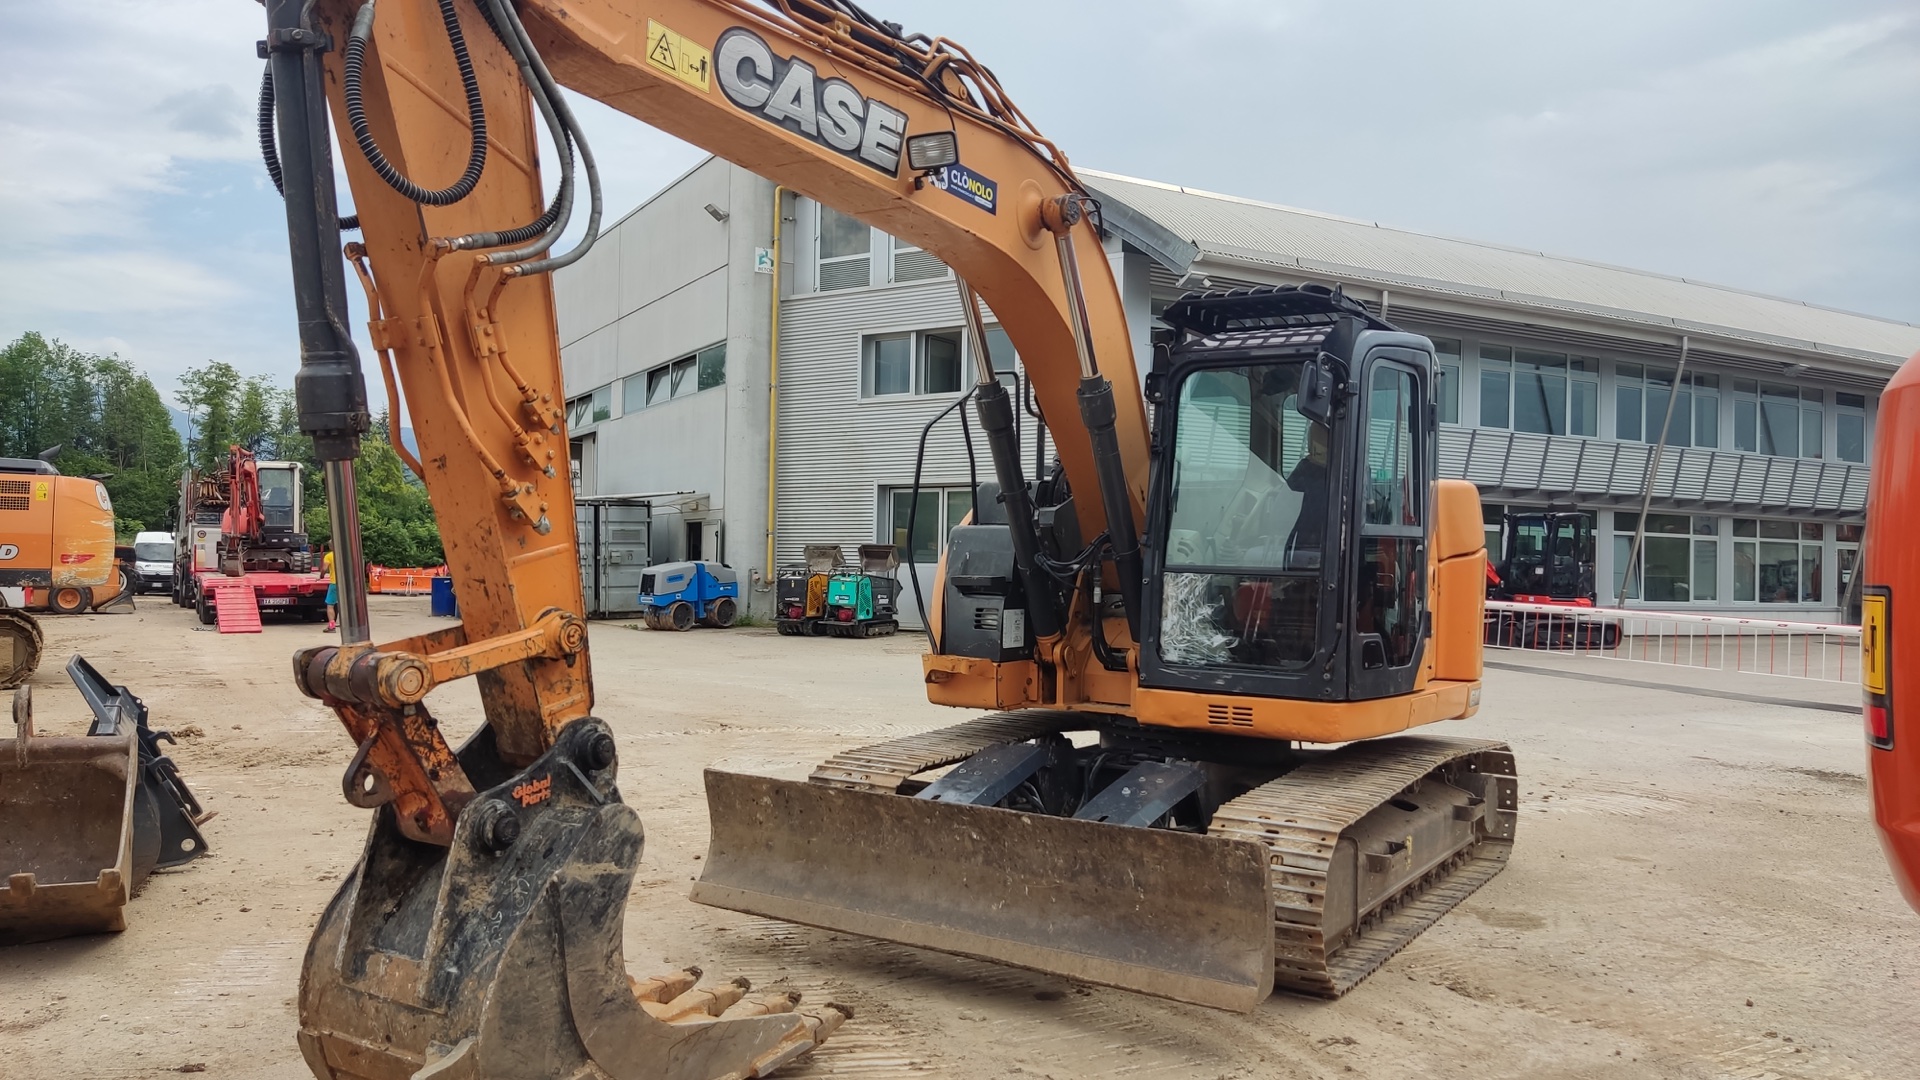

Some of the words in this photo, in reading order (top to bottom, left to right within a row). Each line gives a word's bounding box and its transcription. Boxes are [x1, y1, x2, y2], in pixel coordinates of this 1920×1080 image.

[718, 35, 906, 172] CASE
[950, 169, 994, 201] CLÒNOLO
[511, 772, 552, 799] Global
[521, 789, 552, 808] Parts
